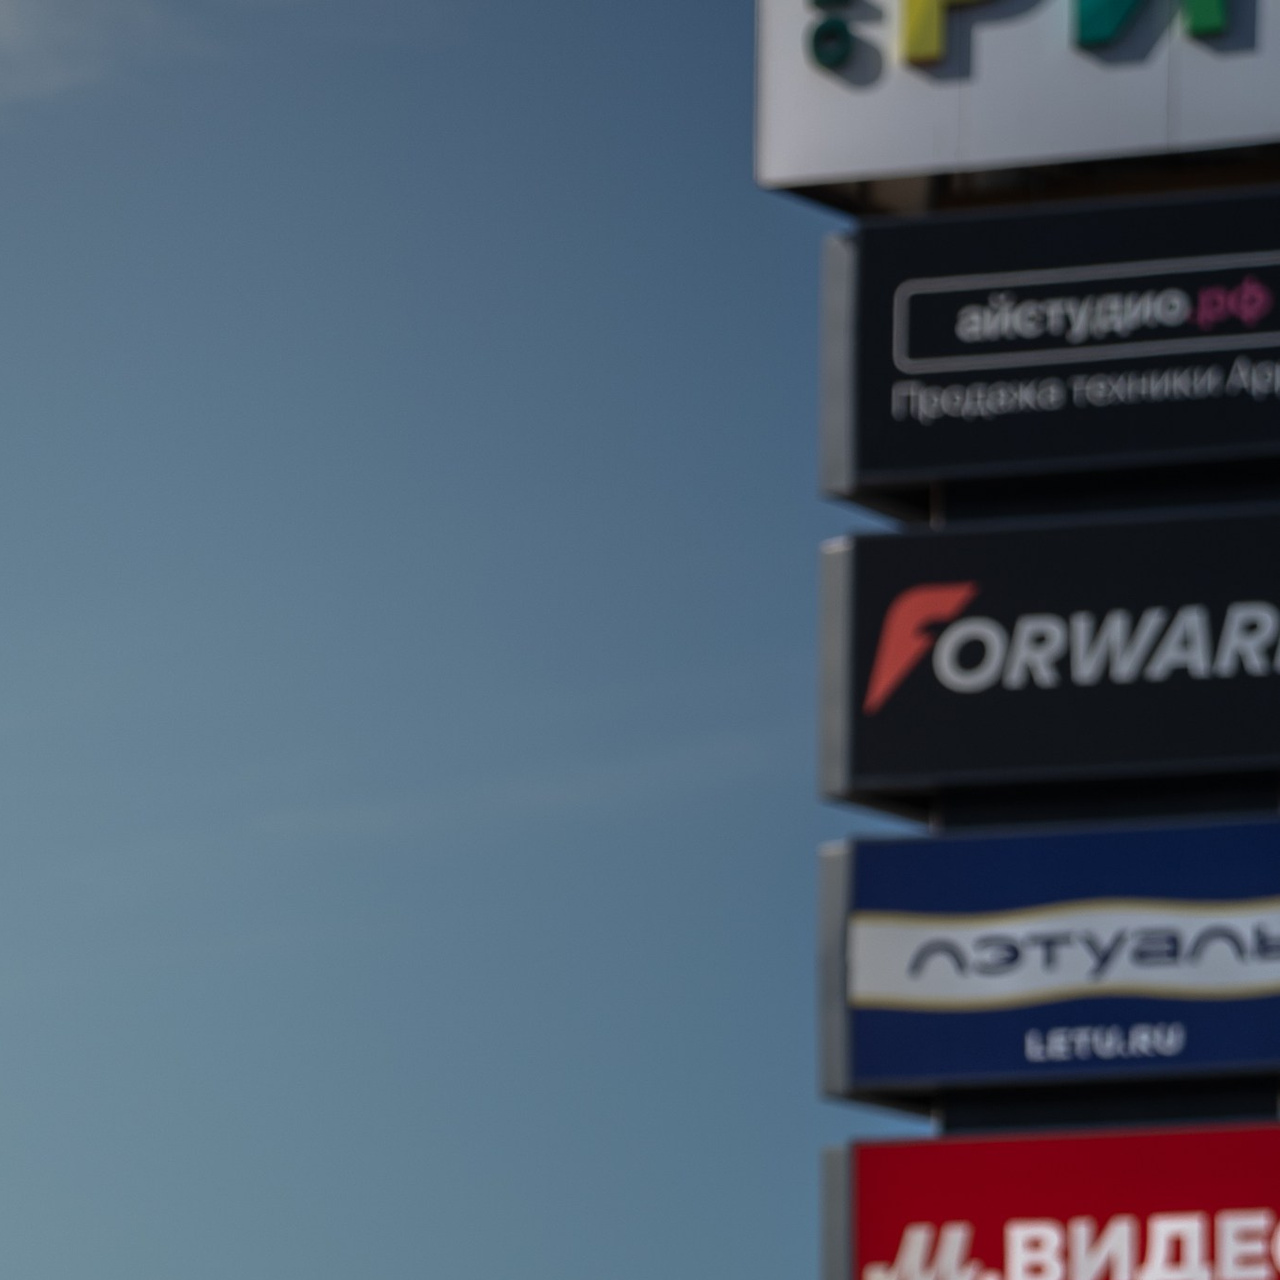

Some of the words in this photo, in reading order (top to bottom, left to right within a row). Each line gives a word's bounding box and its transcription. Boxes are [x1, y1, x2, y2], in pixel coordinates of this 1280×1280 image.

[891, 378, 1066, 425] Продажа
[863, 582, 1280, 715] FORWAR
[1024, 1023, 1186, 1063] LETU.RU
